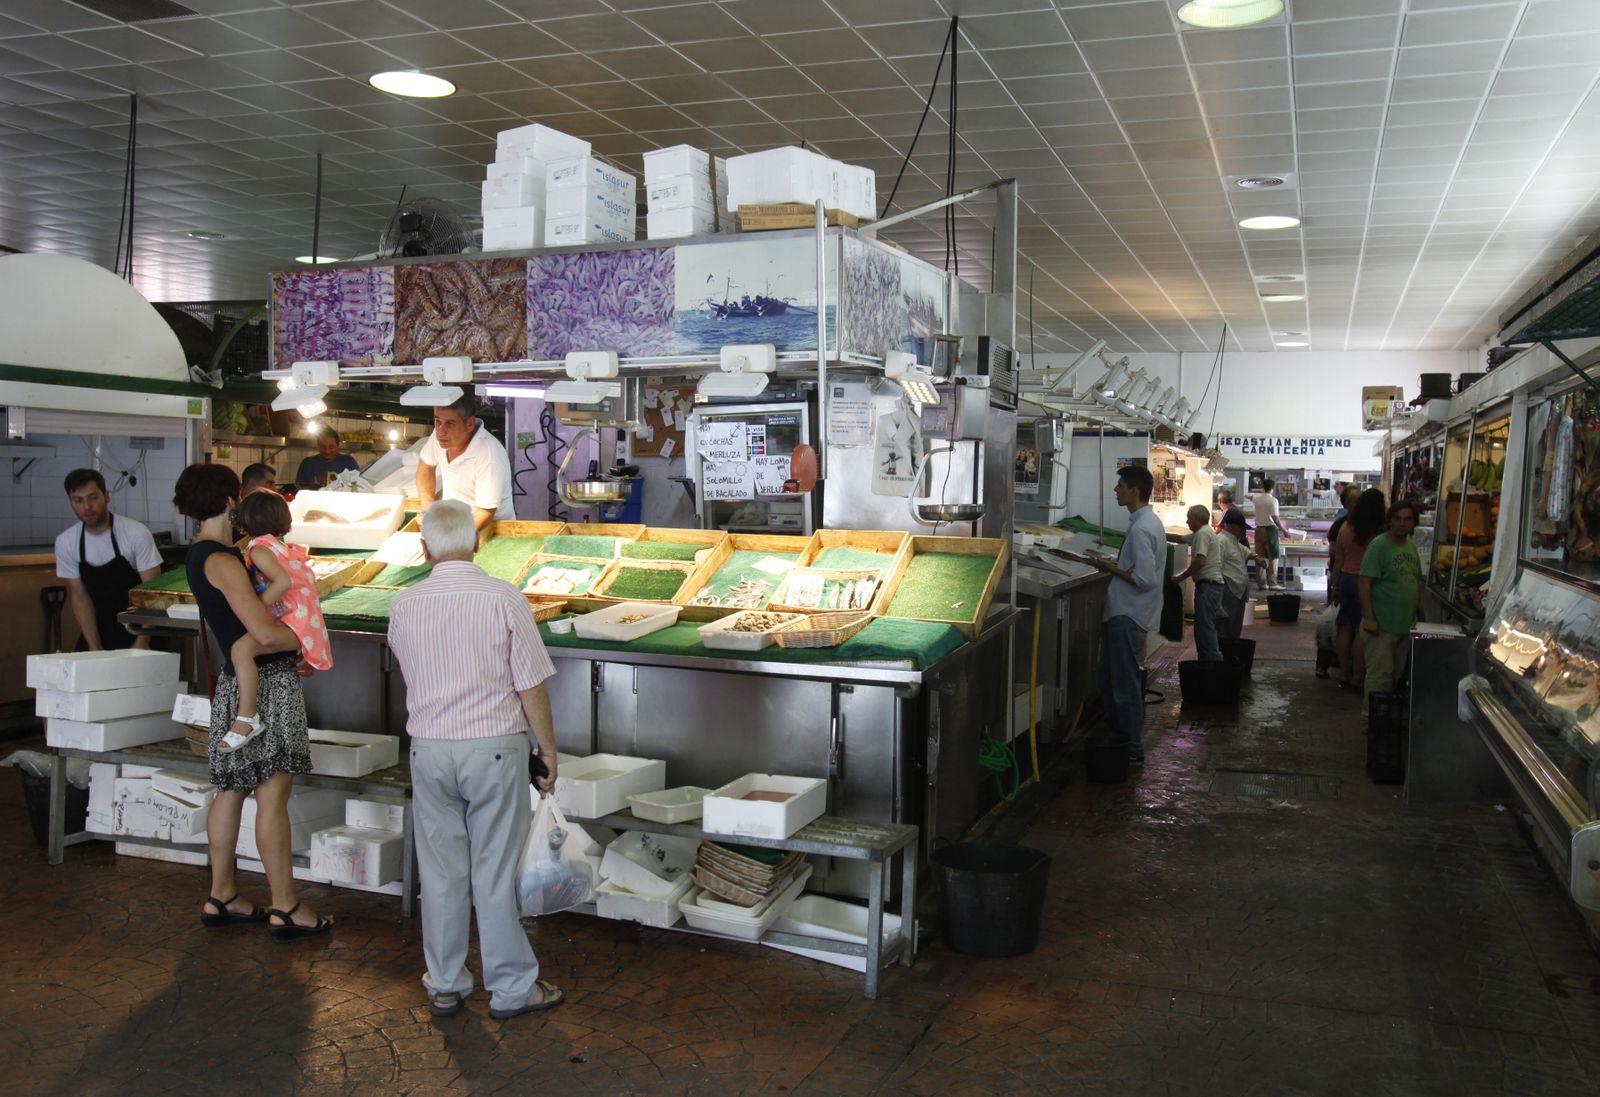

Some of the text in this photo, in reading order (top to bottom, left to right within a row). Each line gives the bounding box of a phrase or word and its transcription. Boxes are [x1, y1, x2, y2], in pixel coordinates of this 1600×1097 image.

[700, 437, 733, 446] CCOCHAS
[1220, 437, 1351, 447] SEBASTIAN MORENO
[709, 450, 741, 458] MERLUZA
[1242, 446, 1324, 455] CARNICERIA
[756, 457, 768, 466] HAY
[706, 476, 742, 484] SOLOMILLO
[715, 489, 747, 497] BACALADO
